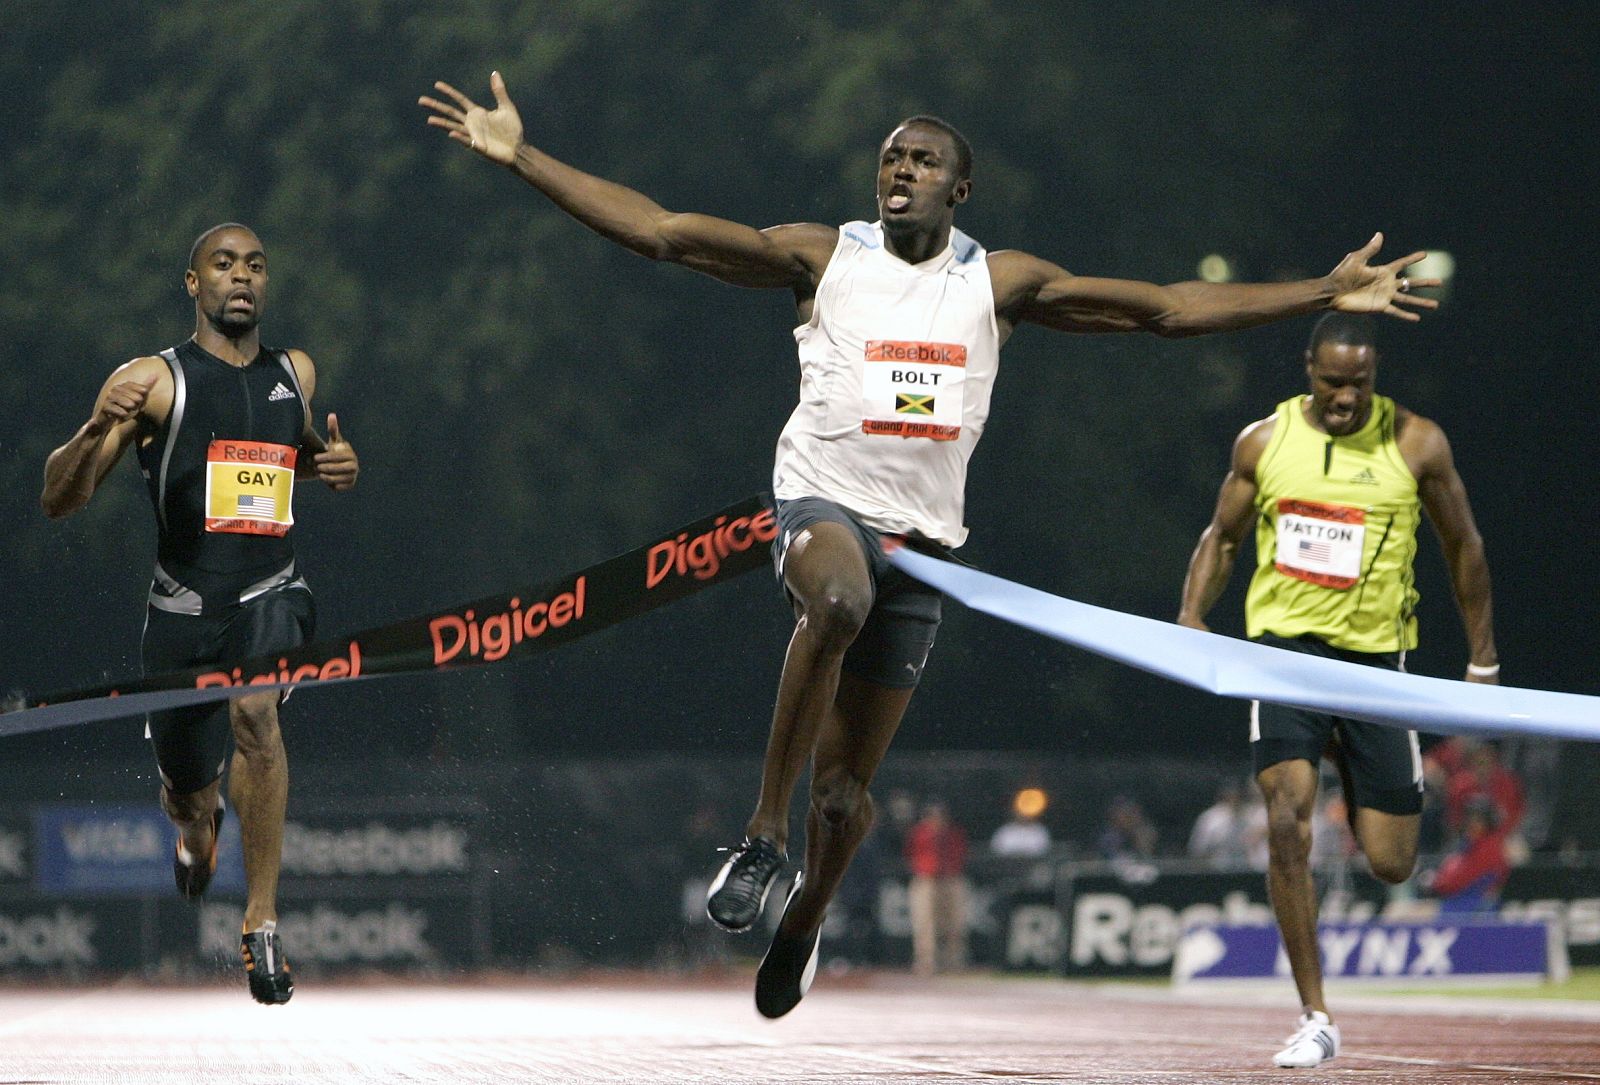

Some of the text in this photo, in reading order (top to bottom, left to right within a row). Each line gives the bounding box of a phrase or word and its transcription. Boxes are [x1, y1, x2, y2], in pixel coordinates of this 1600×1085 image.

[881, 344, 951, 361] Reebok
[891, 370, 942, 386] BOLT
[268, 391, 296, 401] adidas
[224, 444, 287, 465] Reebok
[237, 470, 277, 487] GAY
[1285, 519, 1353, 541] PATTON
[646, 508, 780, 589] Digice
[429, 575, 586, 665] Digicel
[200, 902, 426, 958] Rebok
